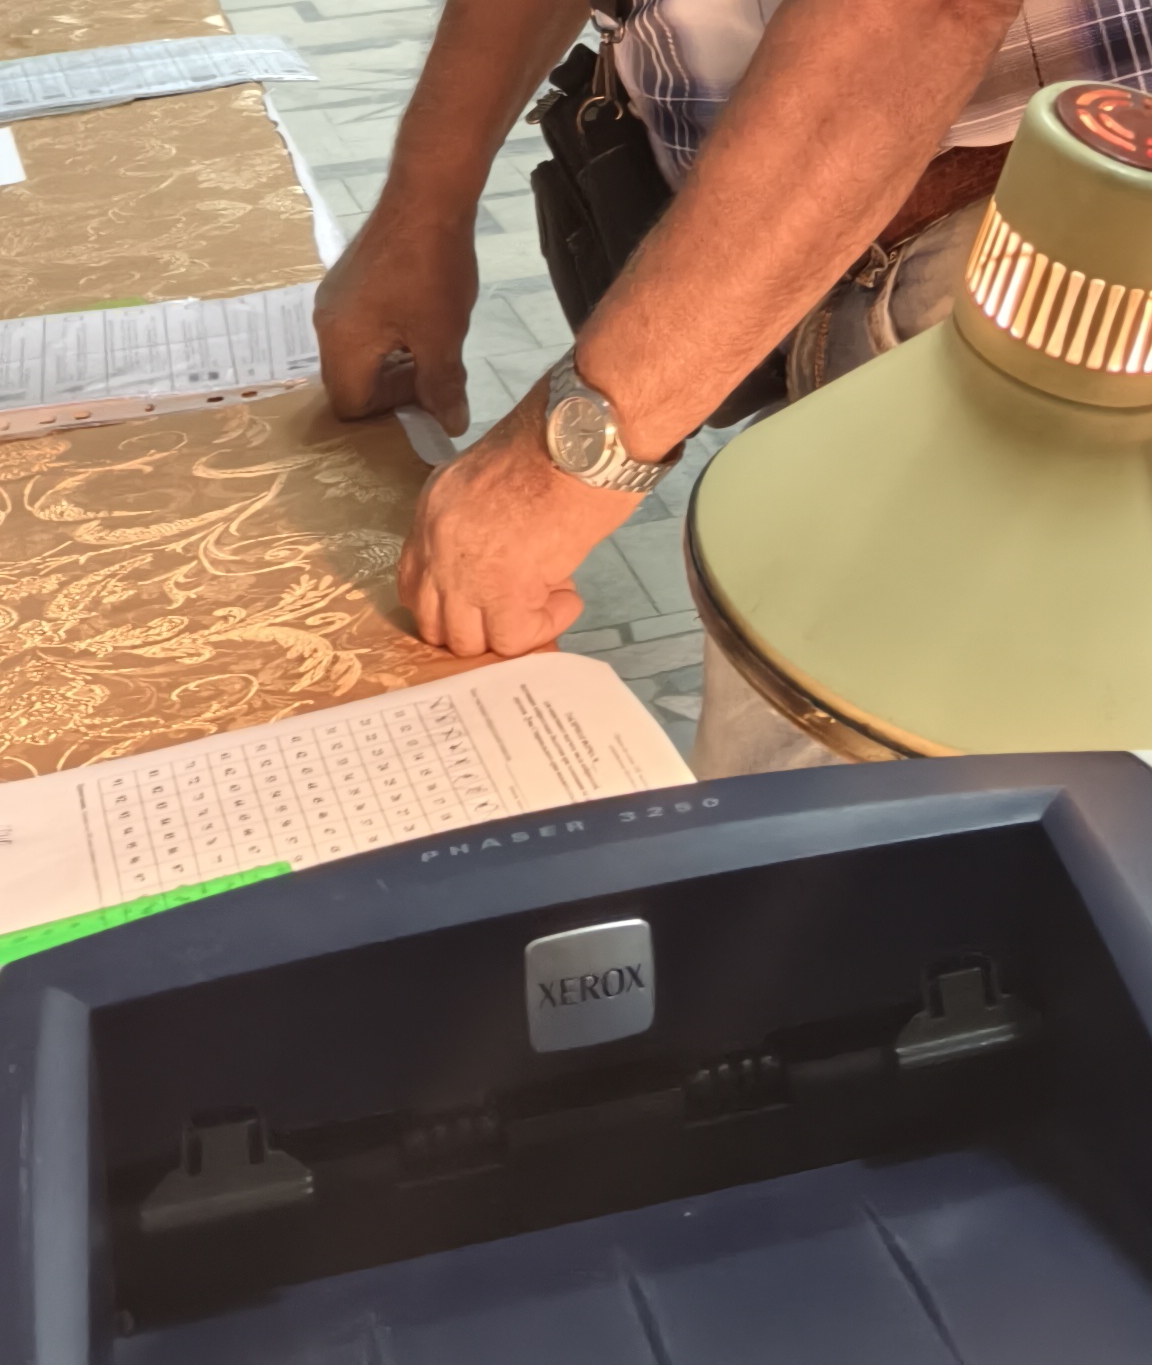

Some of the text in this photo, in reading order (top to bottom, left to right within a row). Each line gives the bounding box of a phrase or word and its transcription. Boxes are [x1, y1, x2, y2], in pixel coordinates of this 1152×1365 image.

[421, 797, 720, 863] PHASER 3250
[538, 963, 646, 1009] XEROX
